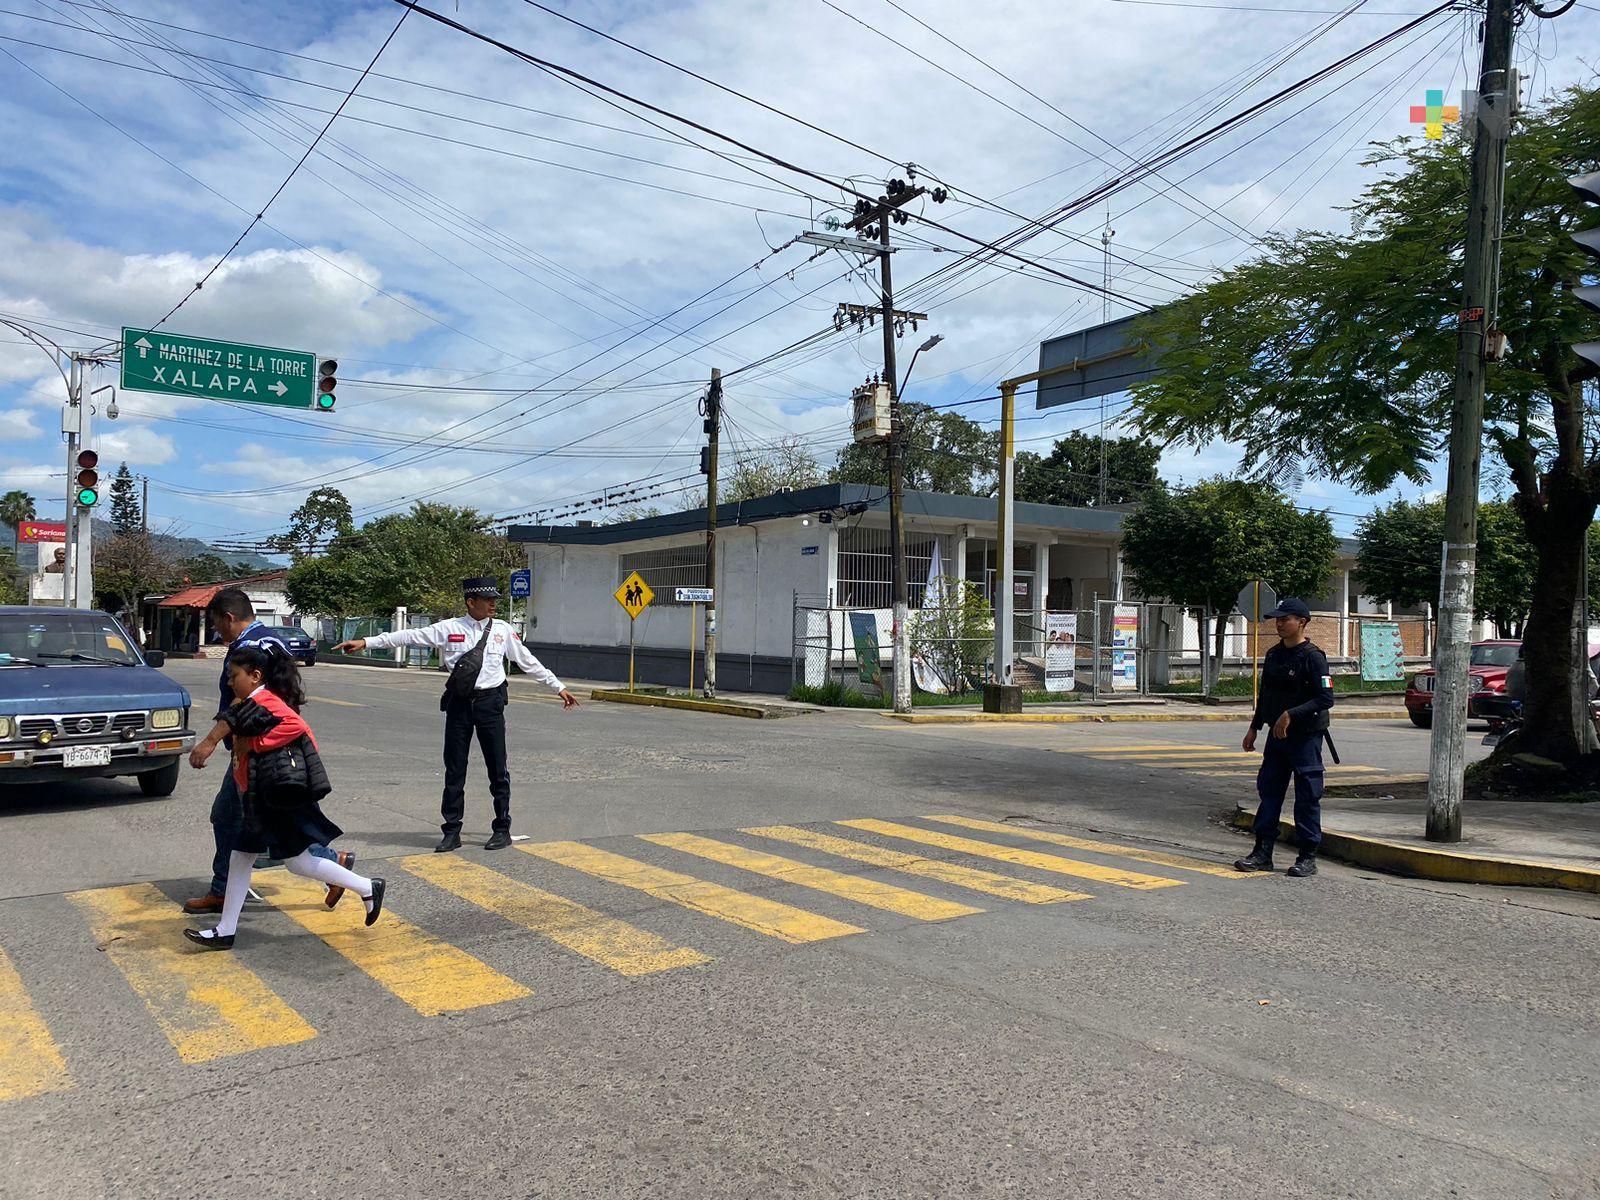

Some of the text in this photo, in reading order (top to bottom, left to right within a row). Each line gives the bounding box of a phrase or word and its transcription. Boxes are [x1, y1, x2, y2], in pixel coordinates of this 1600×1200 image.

[160, 343, 307, 377] MARTINEZ DE LA TORRE
[153, 366, 257, 394] XALAPA
[38, 529, 66, 537] Soriana
